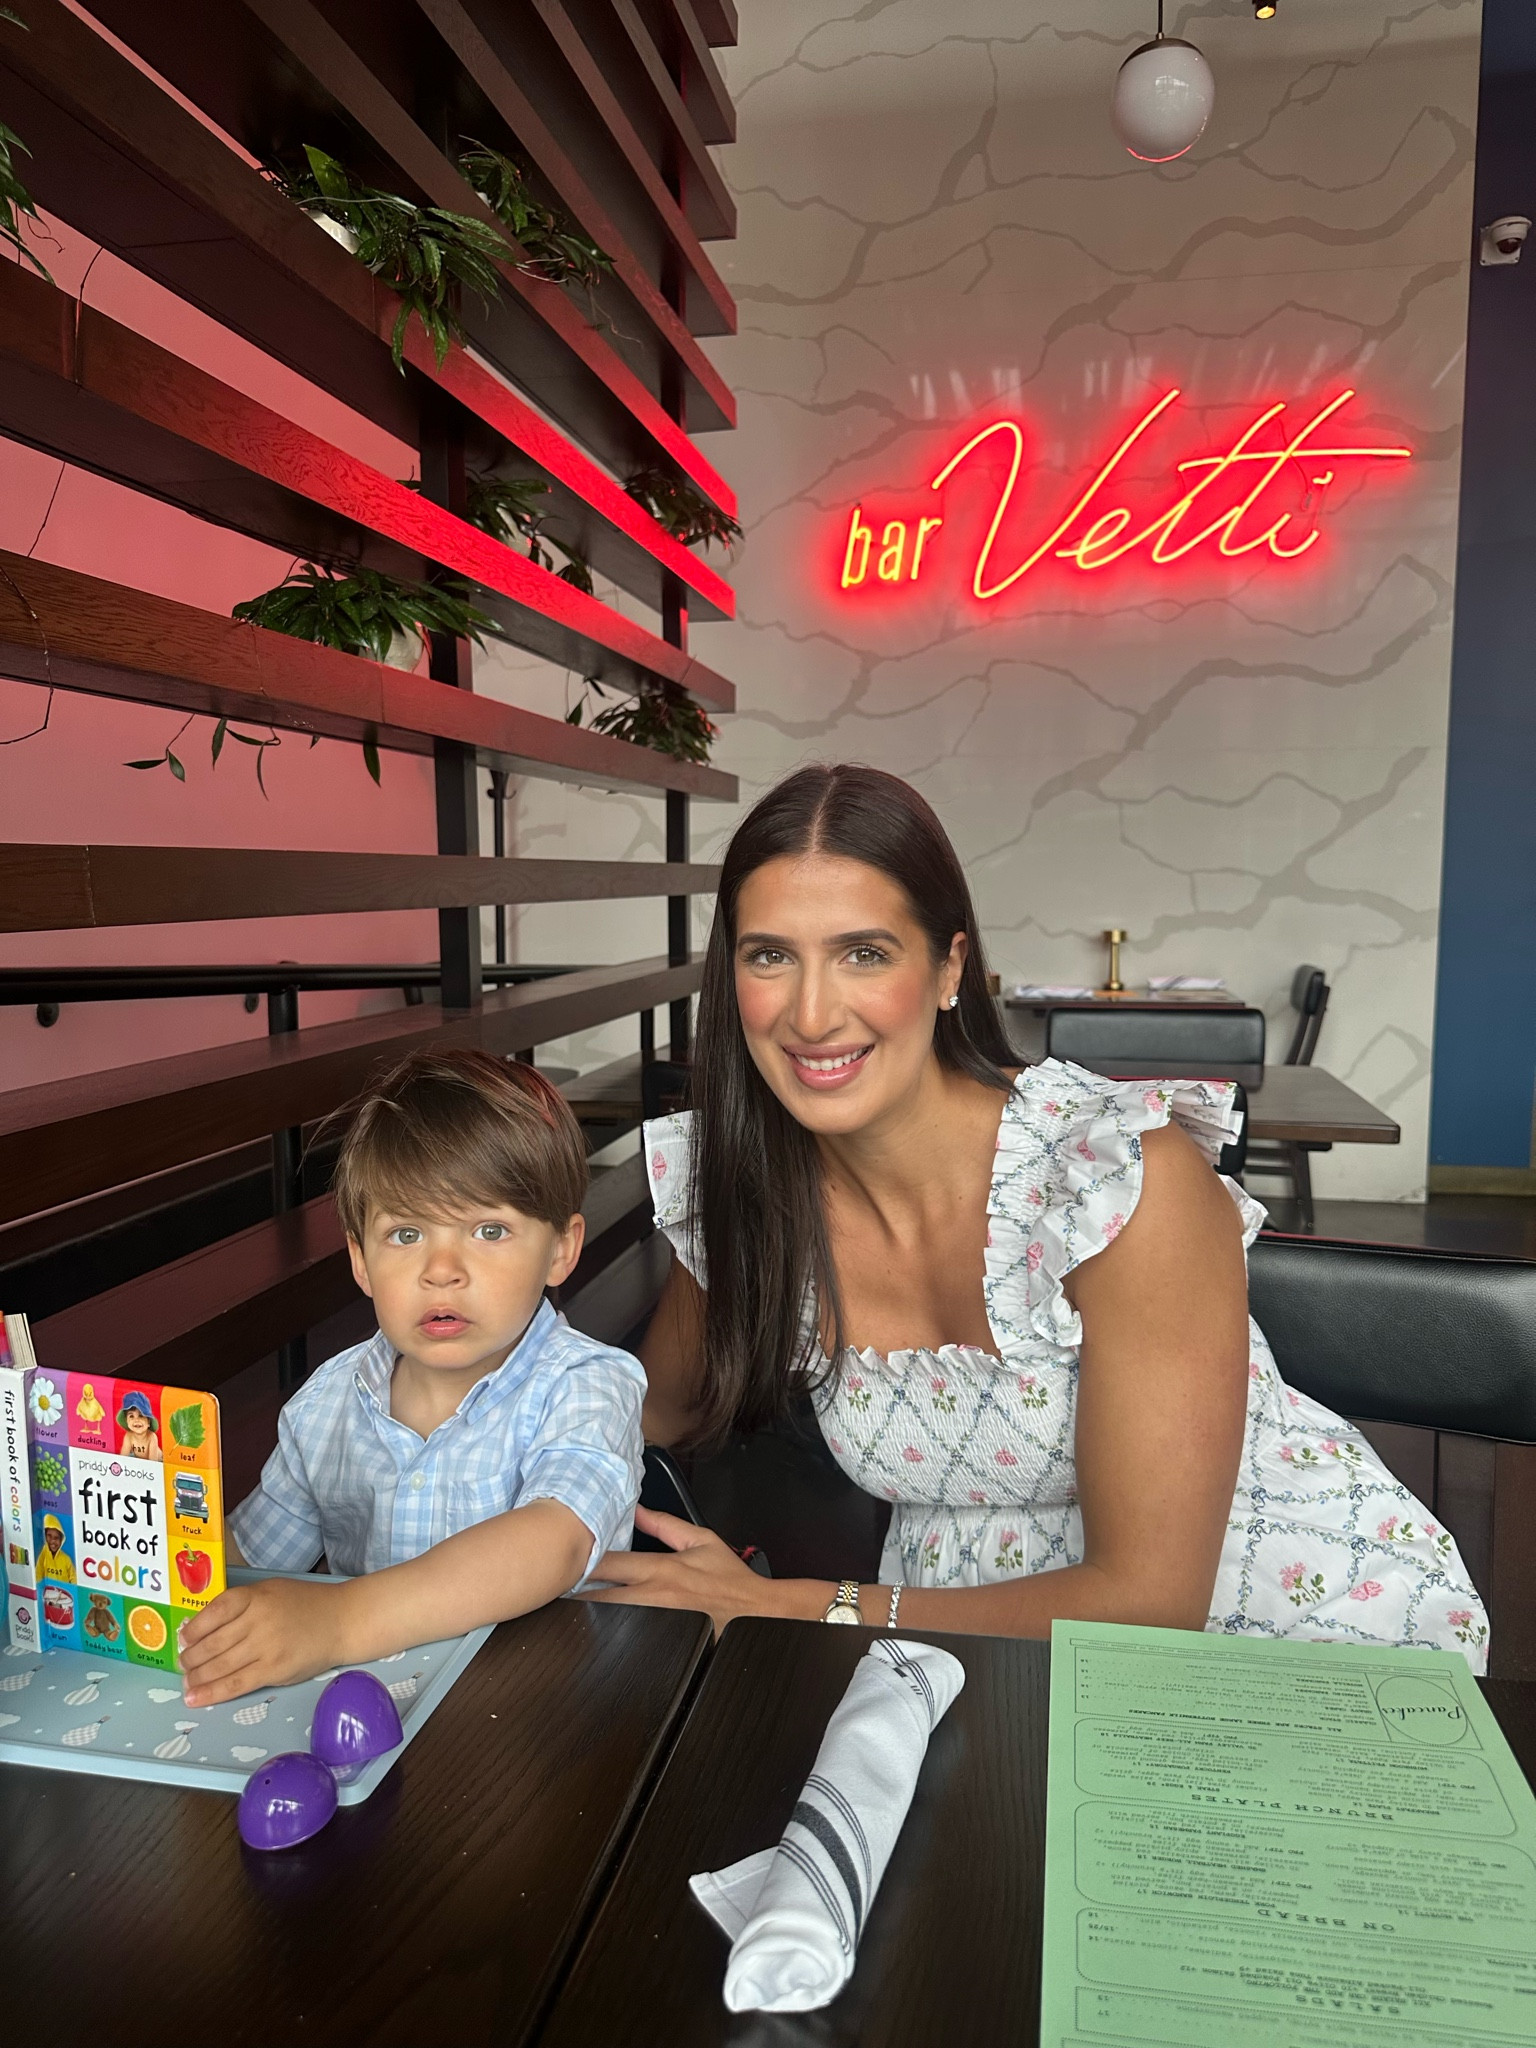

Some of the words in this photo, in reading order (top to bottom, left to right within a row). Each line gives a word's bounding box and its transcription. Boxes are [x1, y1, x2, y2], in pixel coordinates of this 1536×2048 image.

[841, 507, 943, 590] bar
[932, 389, 1413, 600] Vetti
[4, 1389, 16, 1424] first
[6, 1426, 20, 1462] book
[77, 1435, 107, 1449] duckling
[132, 1444, 146, 1453] hat
[180, 1452, 196, 1462] leaf
[9, 1466, 21, 1484] of
[78, 1460, 108, 1476] priddy
[124, 1468, 155, 1480] books
[10, 1485, 22, 1533] colors
[78, 1477, 157, 1527] first
[82, 1520, 131, 1551] book
[136, 1534, 159, 1556] of
[182, 1525, 203, 1535] truck
[46, 1567, 63, 1576] coat
[82, 1555, 163, 1592] colors
[181, 1596, 209, 1608] pepper
[137, 1652, 165, 1665] orange
[1382, 1706, 1461, 1720] Pancakes
[1190, 1793, 1281, 1808] PLATES
[1294, 1803, 1393, 1820] BRUNCH
[1256, 1908, 1346, 1926] BREAD
[1360, 1920, 1394, 1931] ON
[1294, 1993, 1399, 2014] SALADS
